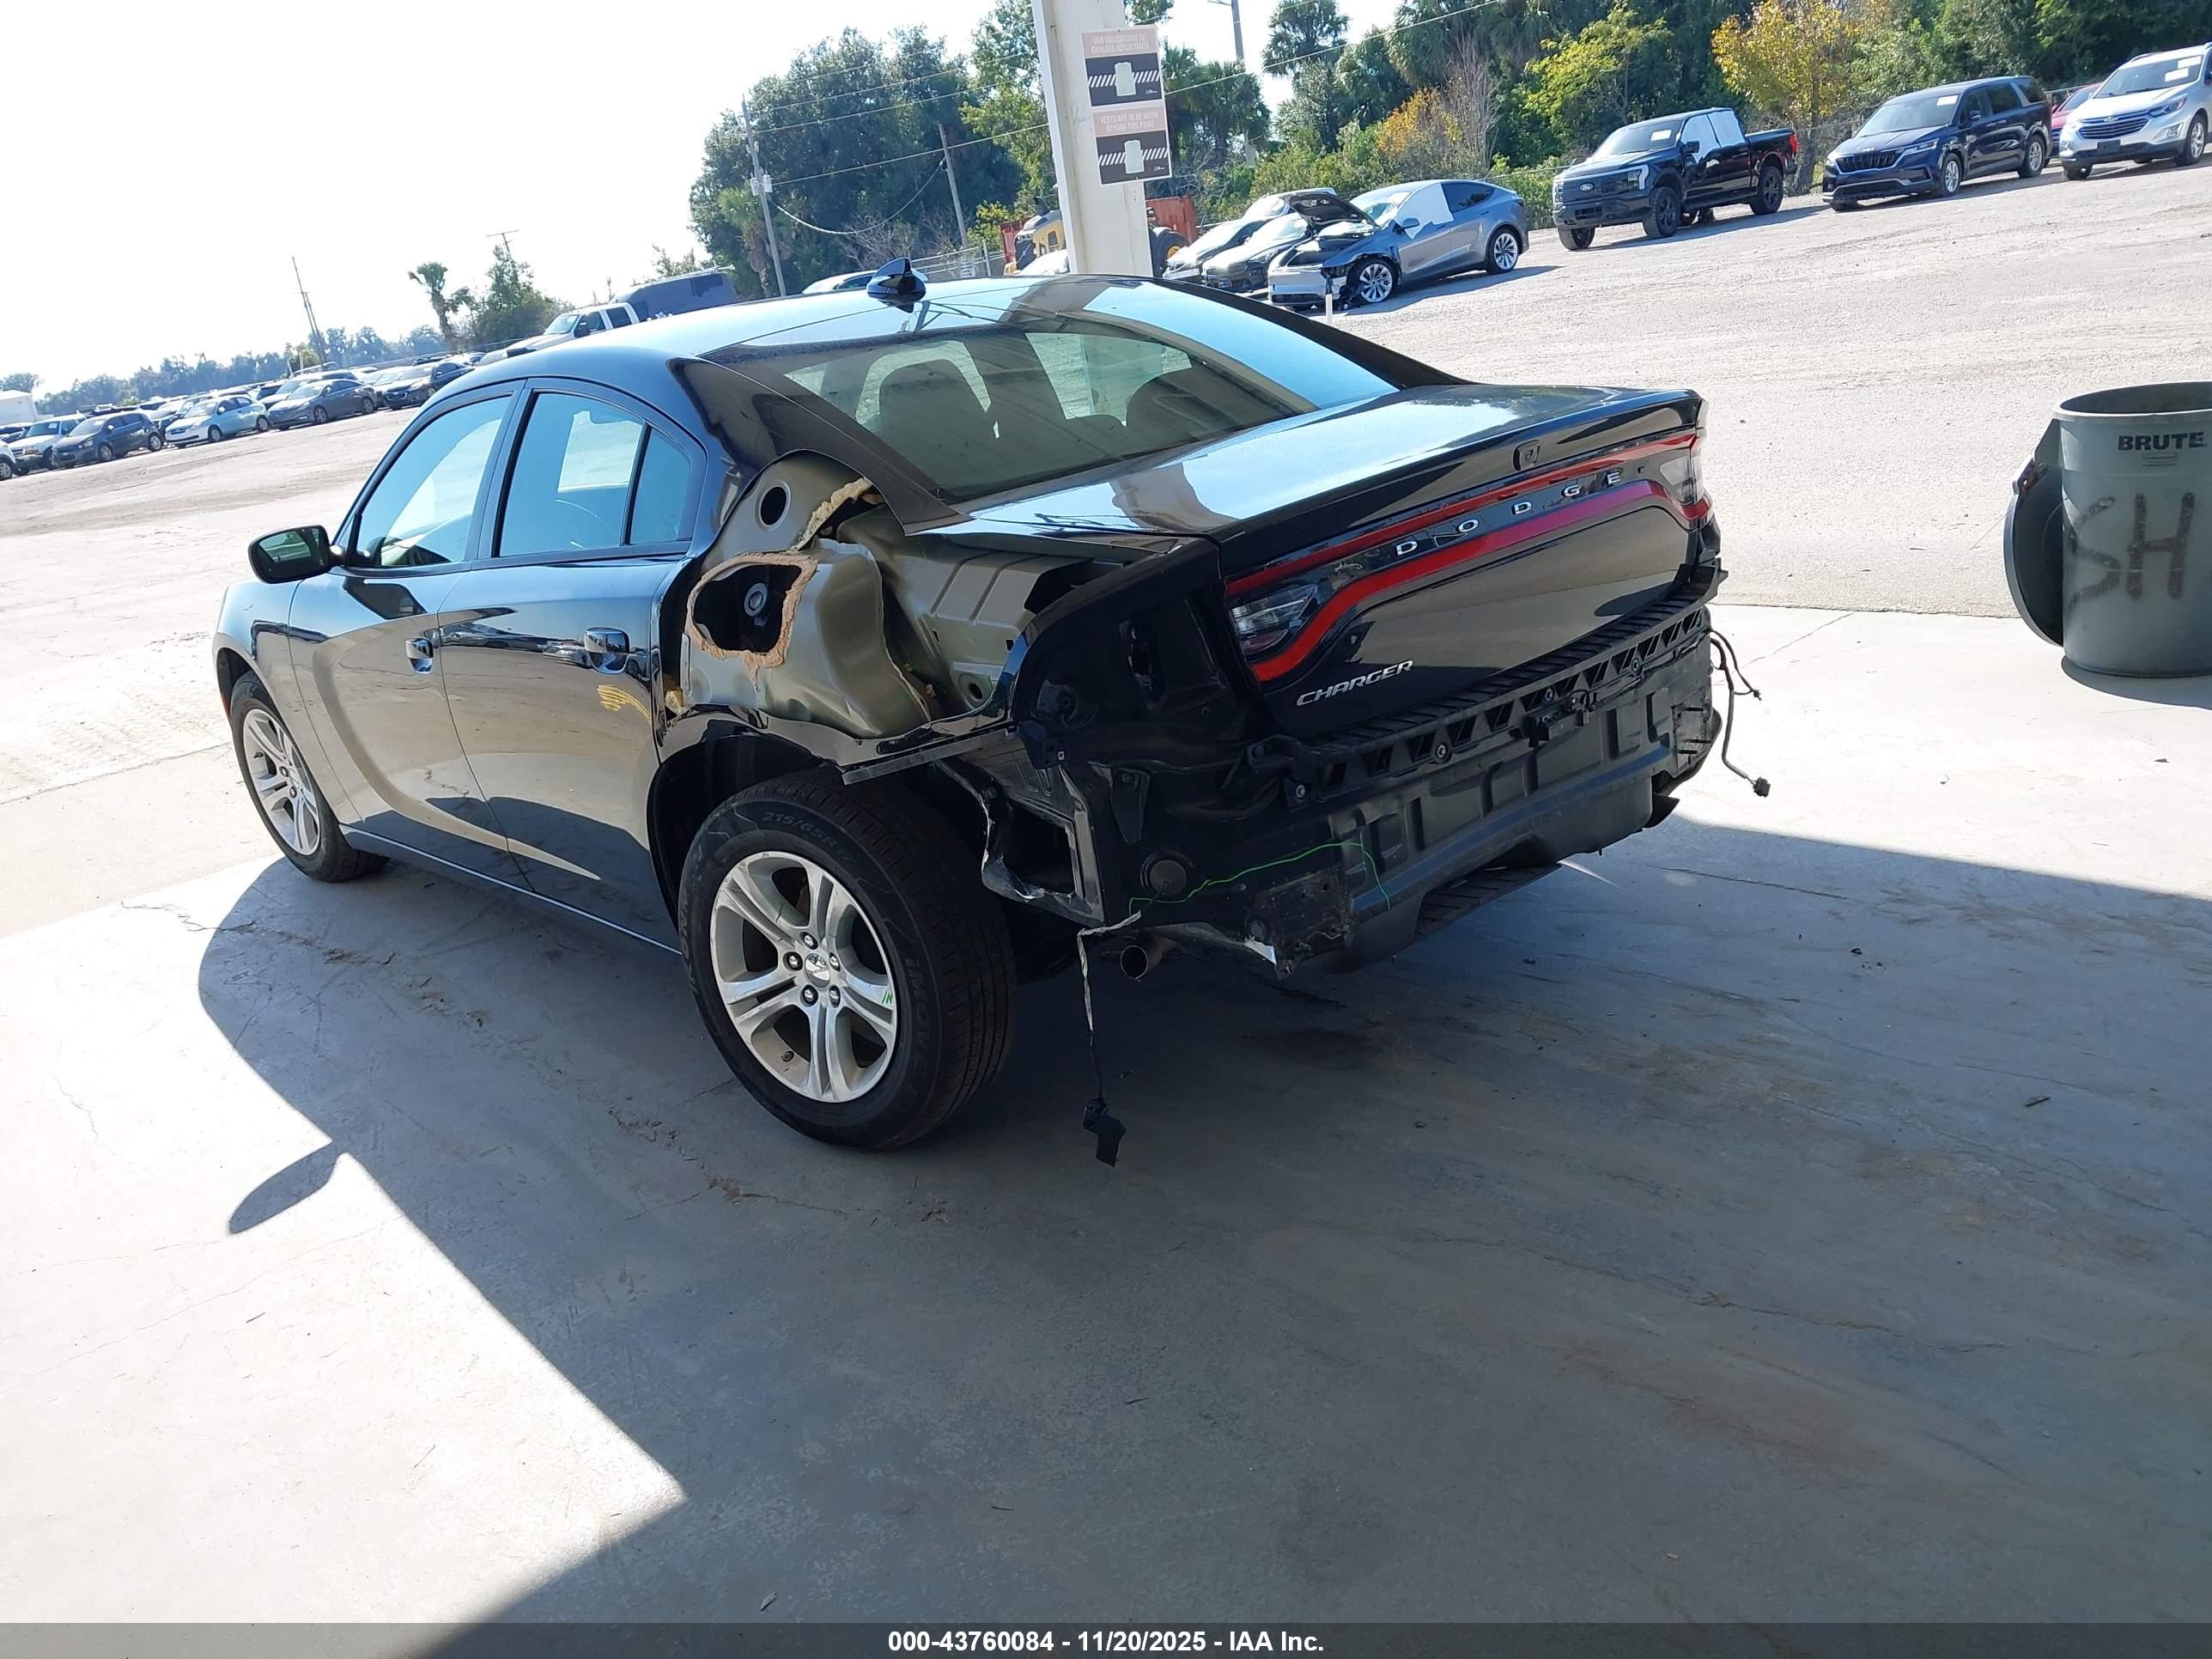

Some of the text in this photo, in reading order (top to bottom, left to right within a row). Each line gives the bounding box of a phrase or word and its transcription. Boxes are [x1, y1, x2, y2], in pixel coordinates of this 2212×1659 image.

[2118, 431, 2205, 451] BRUTE
[1395, 471, 1622, 556] DODGE
[1297, 659, 1413, 707] CHARGER
